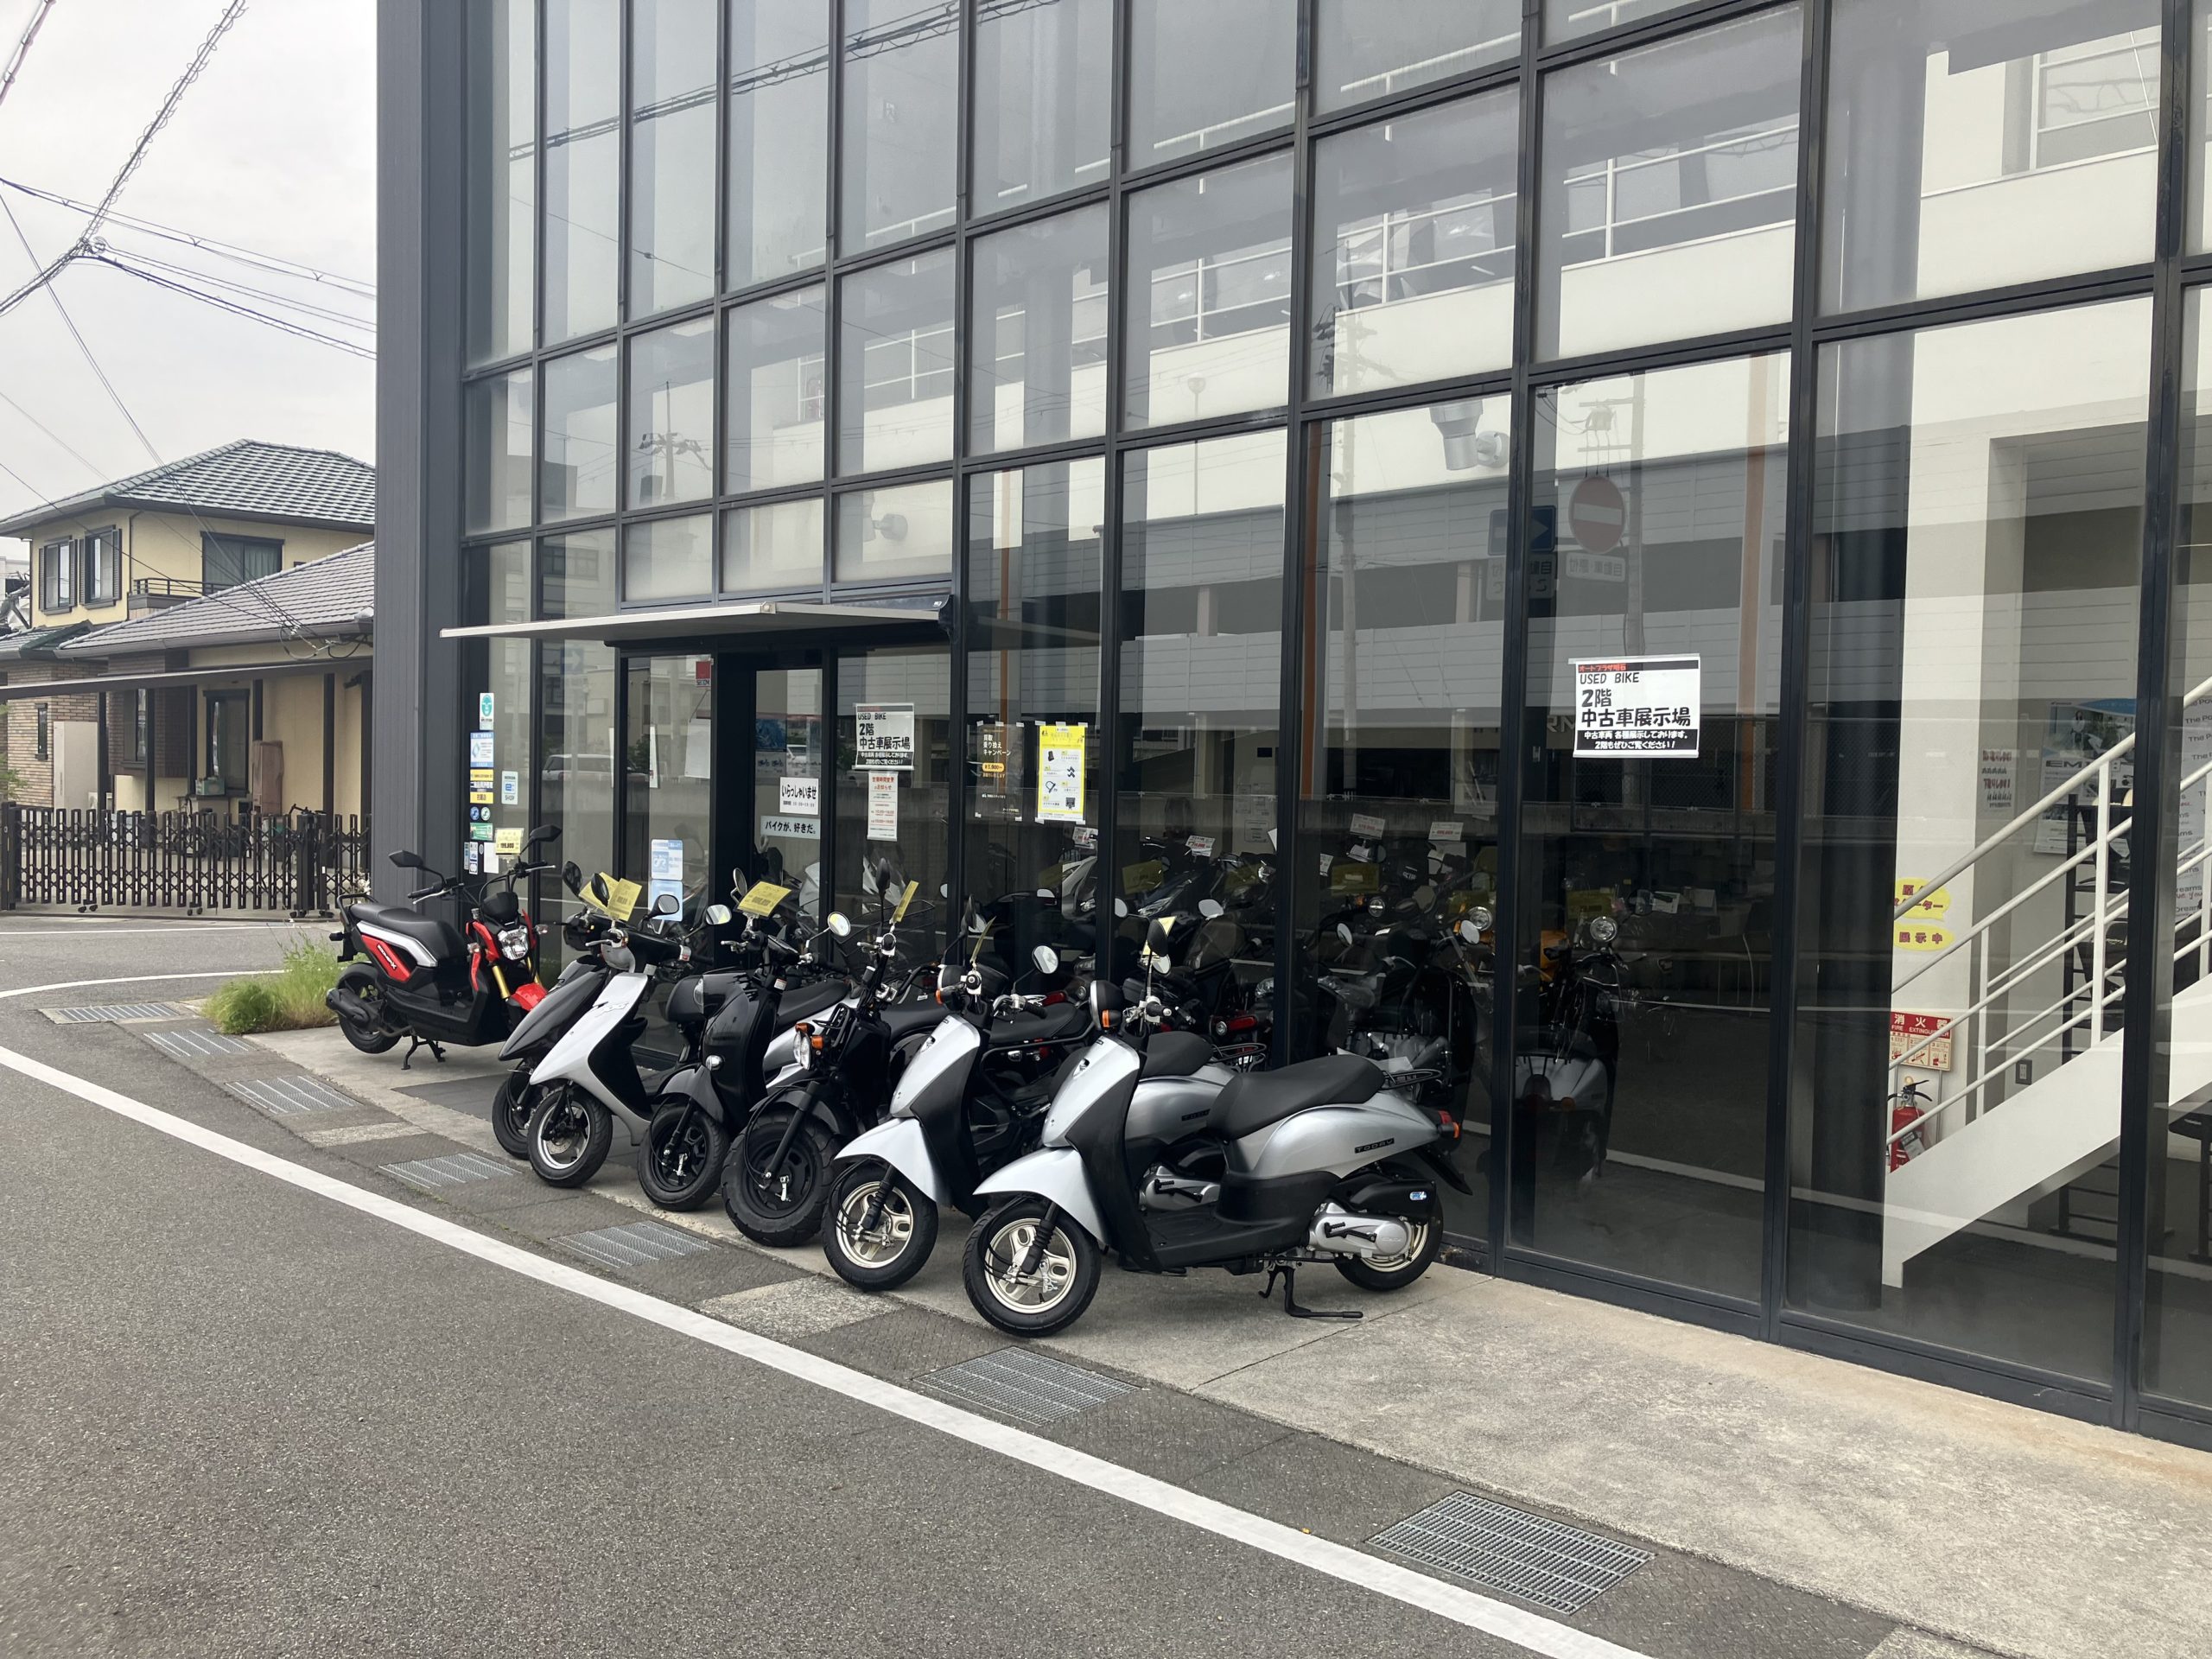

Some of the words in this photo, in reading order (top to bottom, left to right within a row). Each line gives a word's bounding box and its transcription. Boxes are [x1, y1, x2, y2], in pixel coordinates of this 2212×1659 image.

[1580, 673, 1607, 685] USED
[1614, 672, 1640, 683] BIKE
[1581, 688, 1612, 708] 2階
[857, 712, 872, 721] USED
[1581, 707, 1691, 728] 中古車展示場
[2184, 716, 2201, 725] The
[859, 722, 874, 736] 2階
[859, 736, 911, 751] 中古車展示場
[781, 784, 817, 800] いらっしゃいませ
[766, 821, 817, 835] バイクが、好きだ。
[1899, 931, 1943, 944] 展示中
[1894, 1013, 1948, 1031] 消火器
